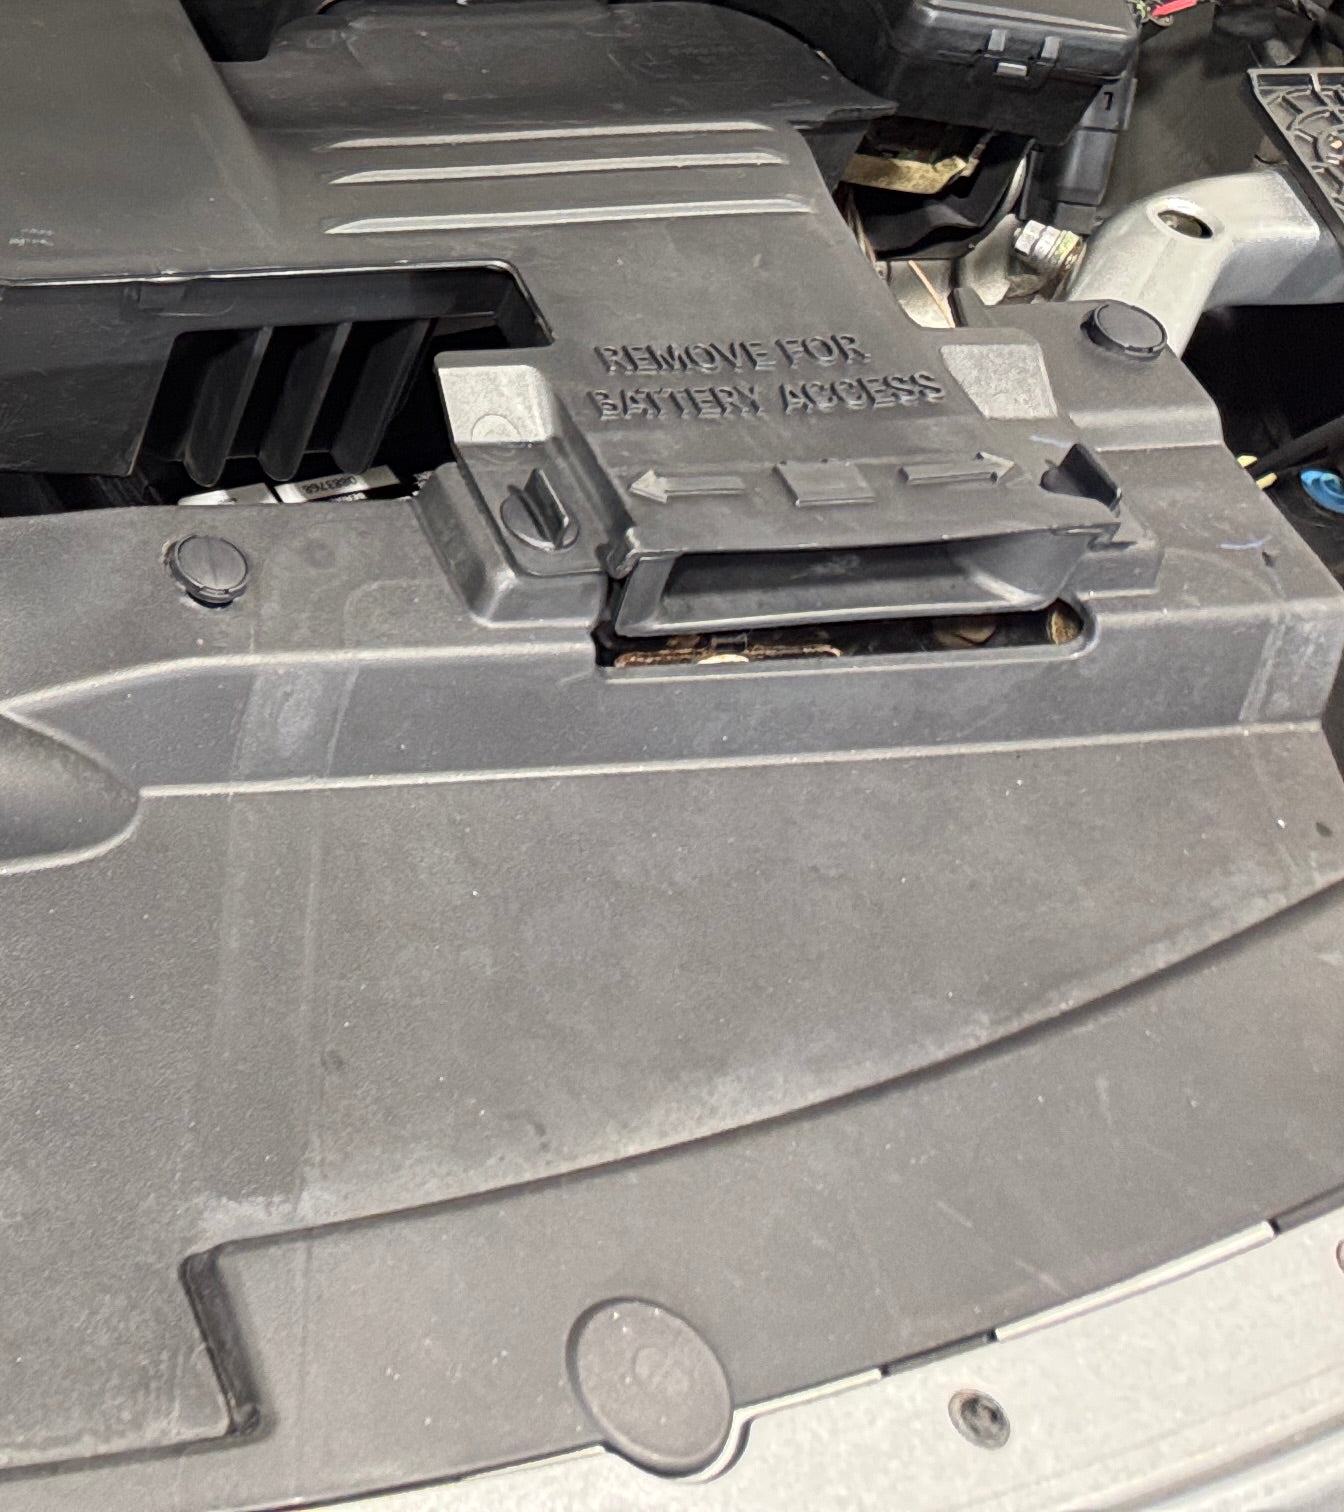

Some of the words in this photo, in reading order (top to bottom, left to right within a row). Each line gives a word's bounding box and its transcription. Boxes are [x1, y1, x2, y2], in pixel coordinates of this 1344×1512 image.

[594, 340, 777, 375] REMOVE
[775, 333, 872, 370] FOR
[588, 385, 765, 422] BATTERY
[778, 370, 947, 415] ACCESS
